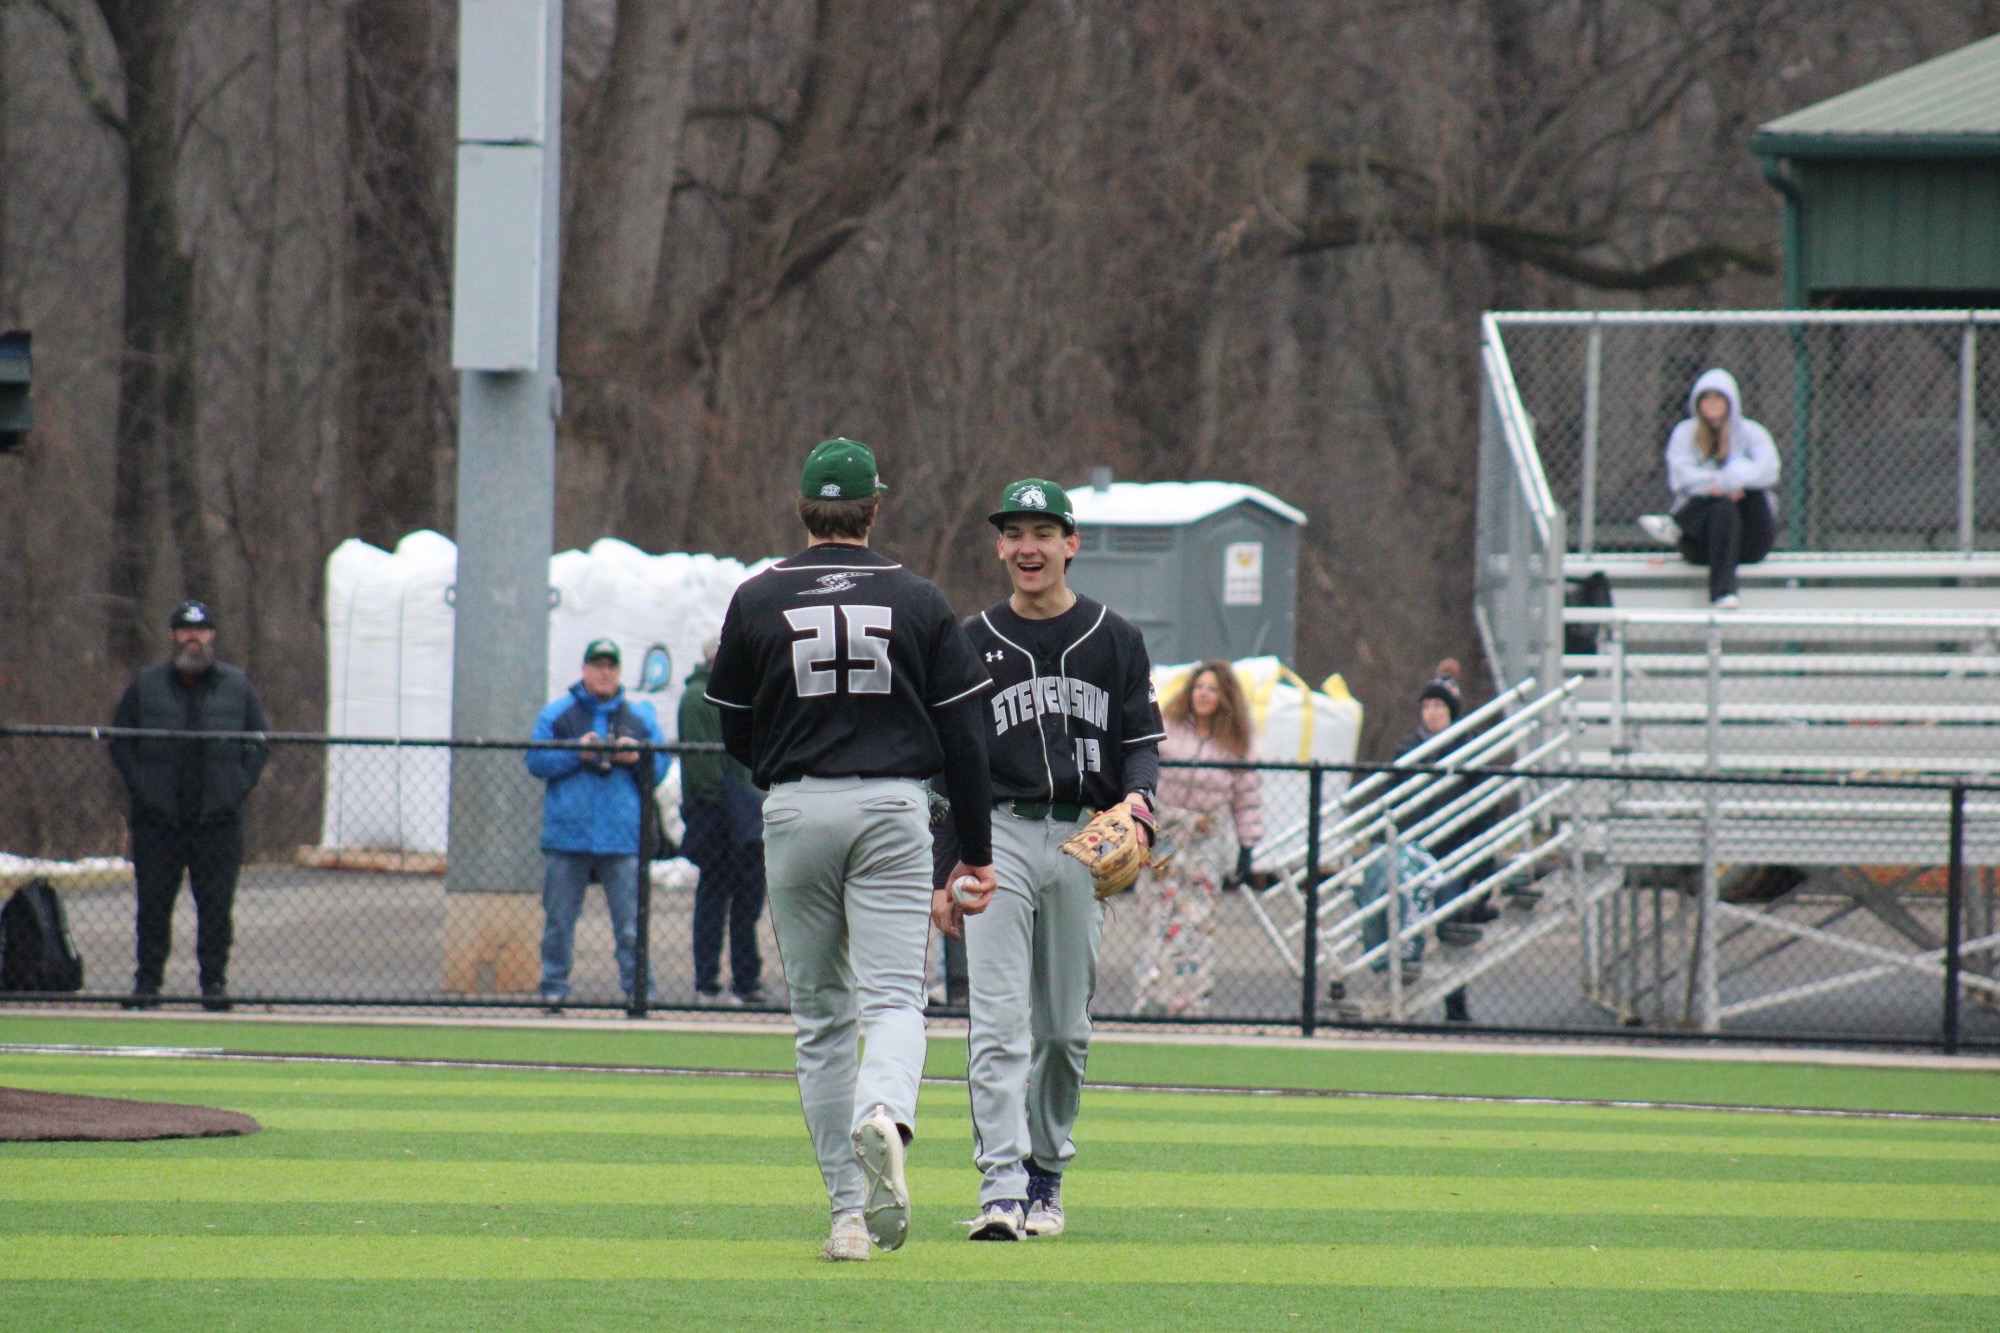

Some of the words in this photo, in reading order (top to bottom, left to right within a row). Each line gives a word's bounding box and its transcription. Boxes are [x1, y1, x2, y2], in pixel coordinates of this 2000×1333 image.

[783, 605, 892, 697] 25
[991, 676, 1109, 736] STEVENSON
[1075, 738, 1100, 772] 19
